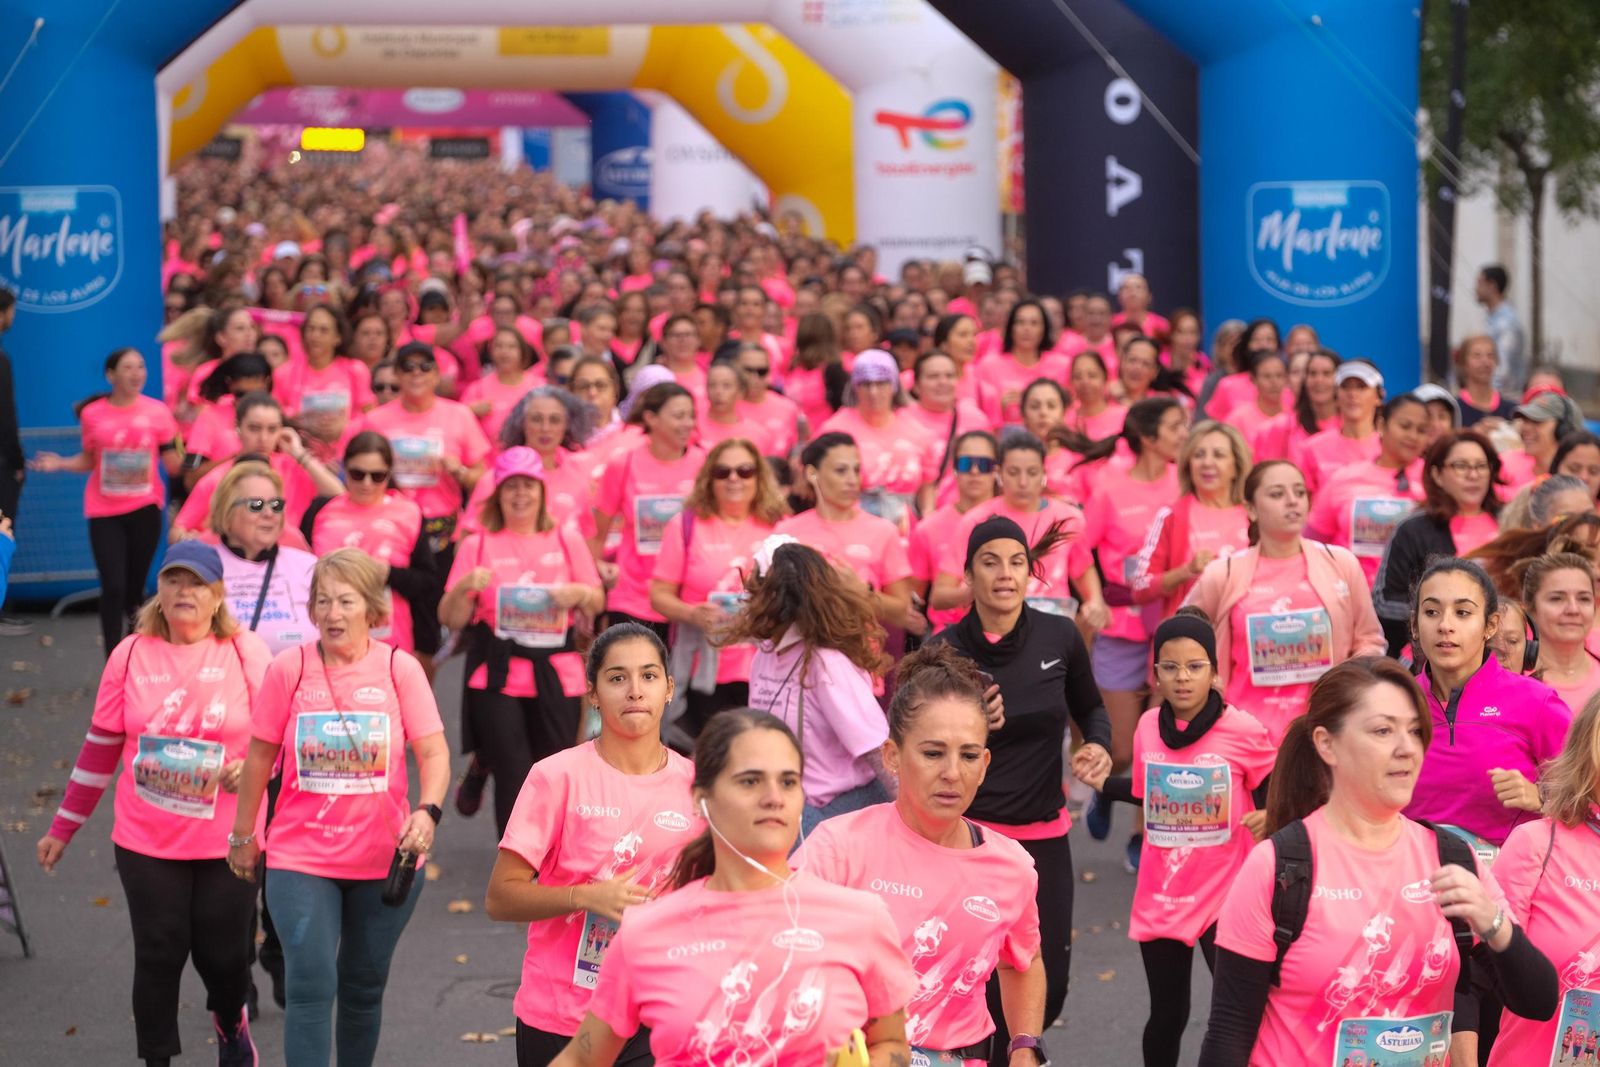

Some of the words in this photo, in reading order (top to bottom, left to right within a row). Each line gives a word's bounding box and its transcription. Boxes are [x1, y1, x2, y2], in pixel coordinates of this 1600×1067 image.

[1104, 78, 1144, 294] LVO
[0, 213, 114, 278] Marlene
[1256, 210, 1382, 272] Marlene
[1277, 643, 1307, 657] 016
[1168, 776, 1202, 786] ASTURIANA
[576, 802, 621, 818] OYSHO
[1168, 801, 1203, 816] 016
[871, 878, 923, 899] OYSHO
[1564, 875, 1600, 893] OYSH
[1312, 885, 1363, 901] OYSHO
[667, 939, 726, 961] OYSHO
[1380, 1035, 1422, 1047] ASTURIANA
